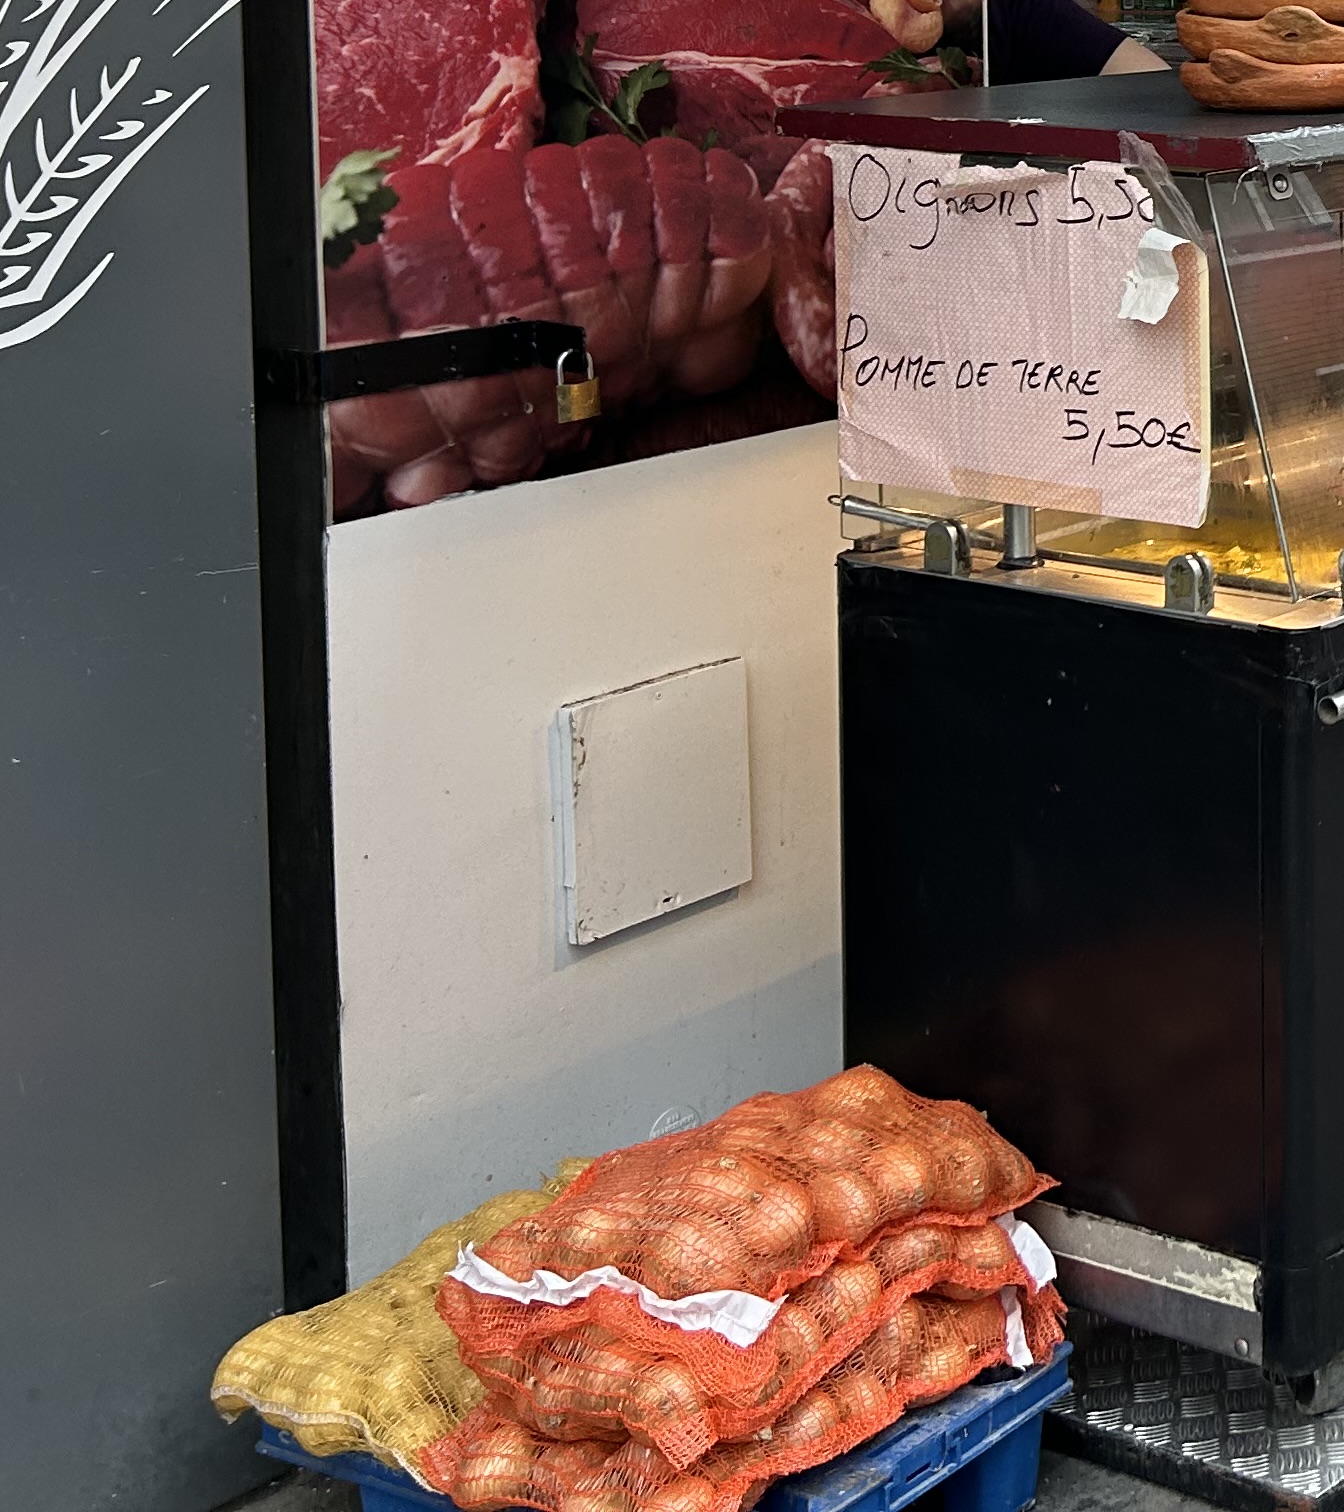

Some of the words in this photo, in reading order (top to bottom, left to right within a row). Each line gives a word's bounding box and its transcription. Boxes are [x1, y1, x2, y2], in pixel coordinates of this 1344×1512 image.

[840, 313, 947, 393] POMME
[956, 360, 998, 390] DE
[1010, 357, 1101, 397] TERRE
[1061, 407, 1202, 466] 5,50€
